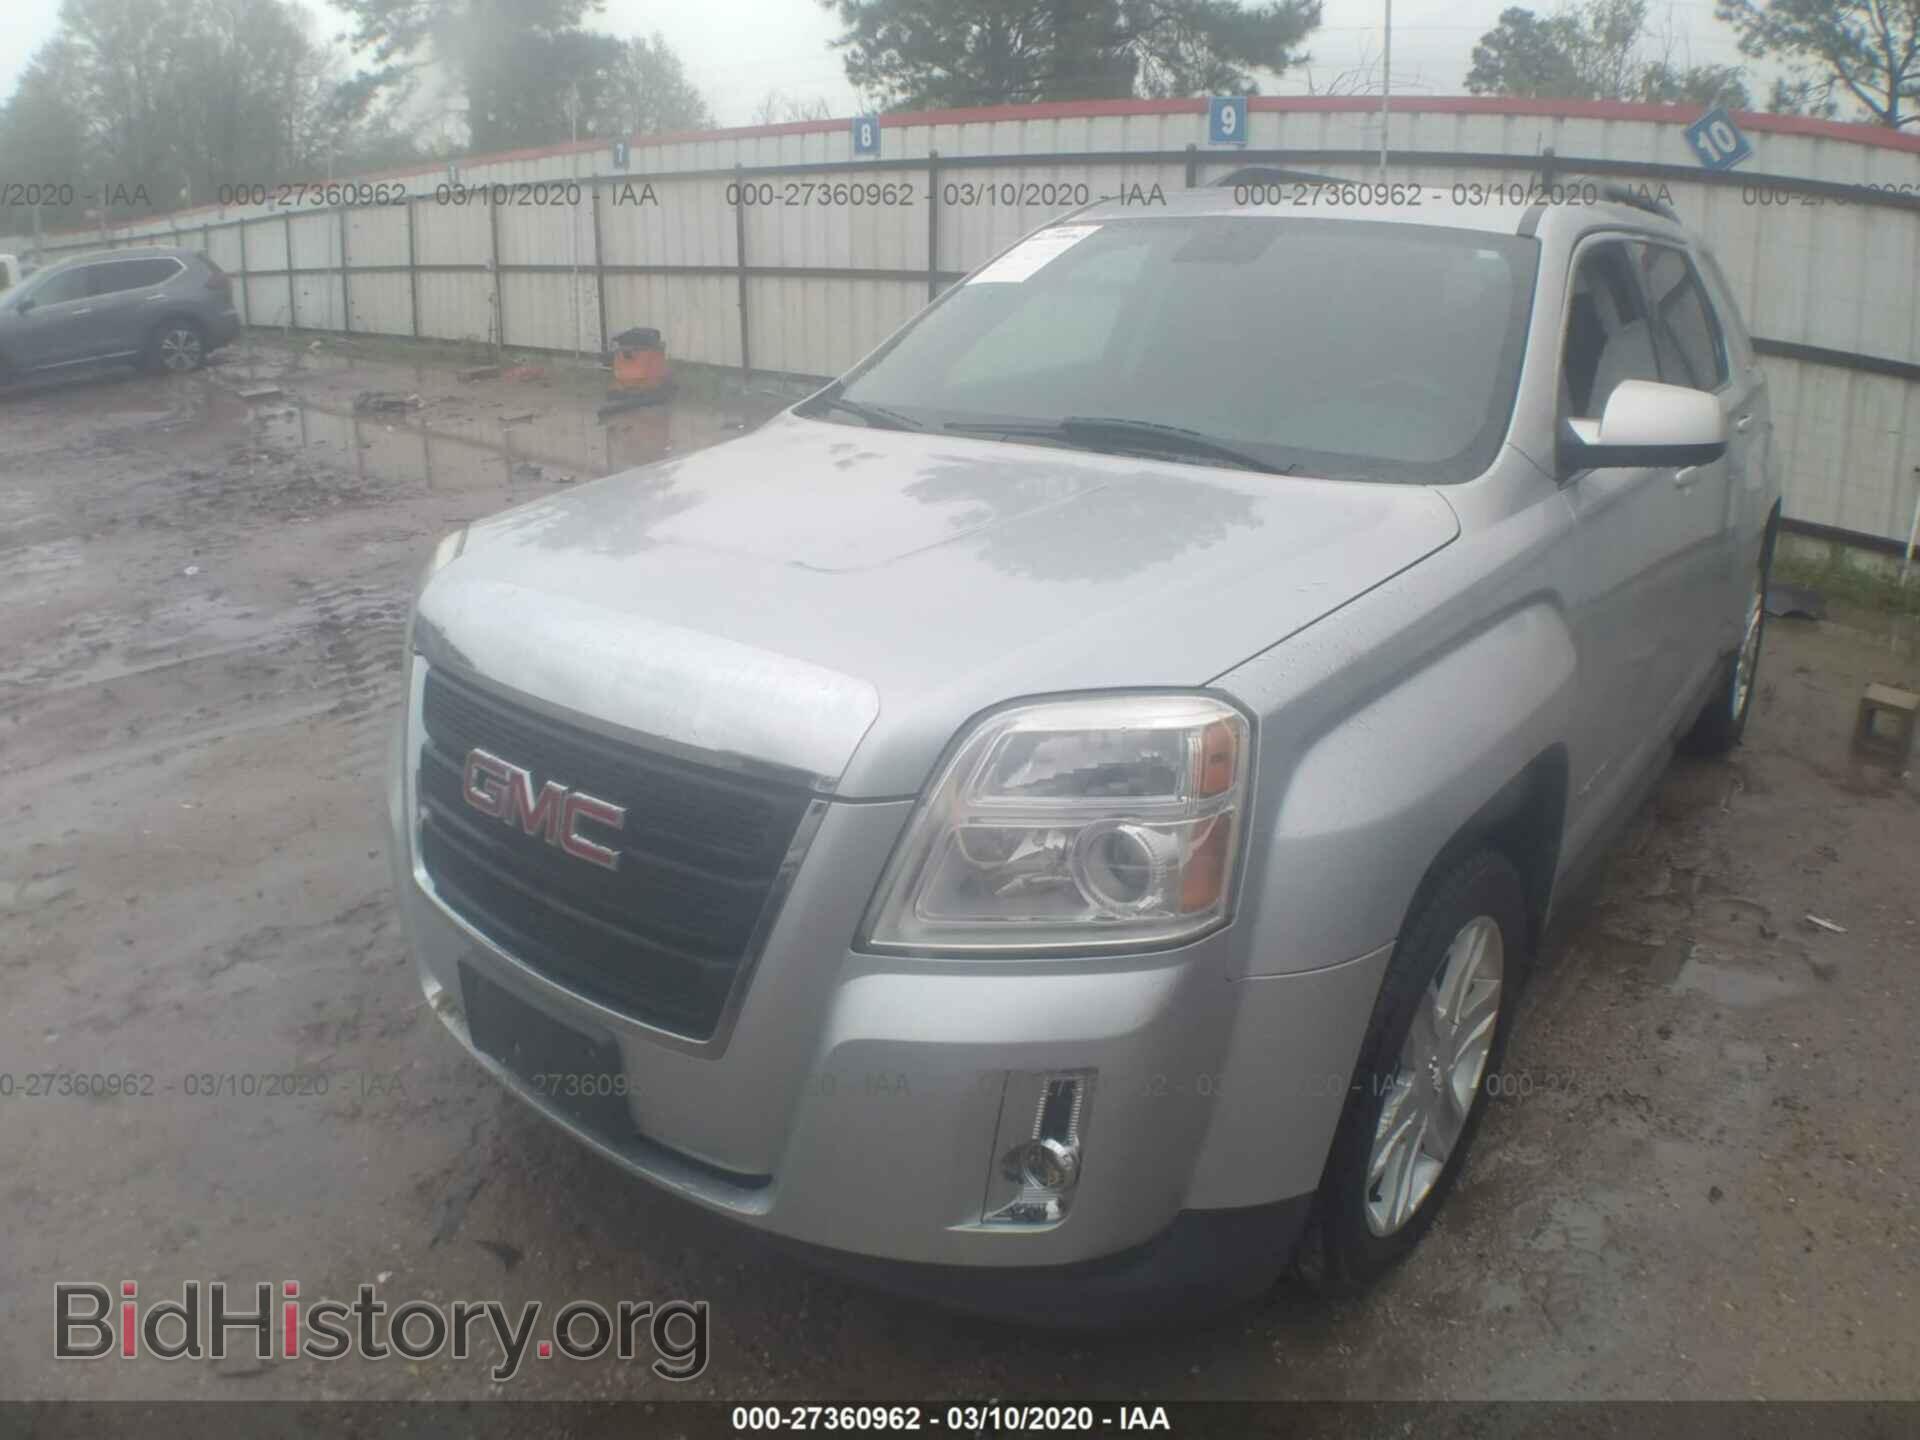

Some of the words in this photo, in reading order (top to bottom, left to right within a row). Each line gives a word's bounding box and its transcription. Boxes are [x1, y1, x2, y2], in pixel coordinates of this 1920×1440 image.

[861, 124, 872, 147] 8
[1221, 105, 1236, 135] 9
[1697, 120, 1737, 162] 10
[462, 746, 627, 871] GMC
